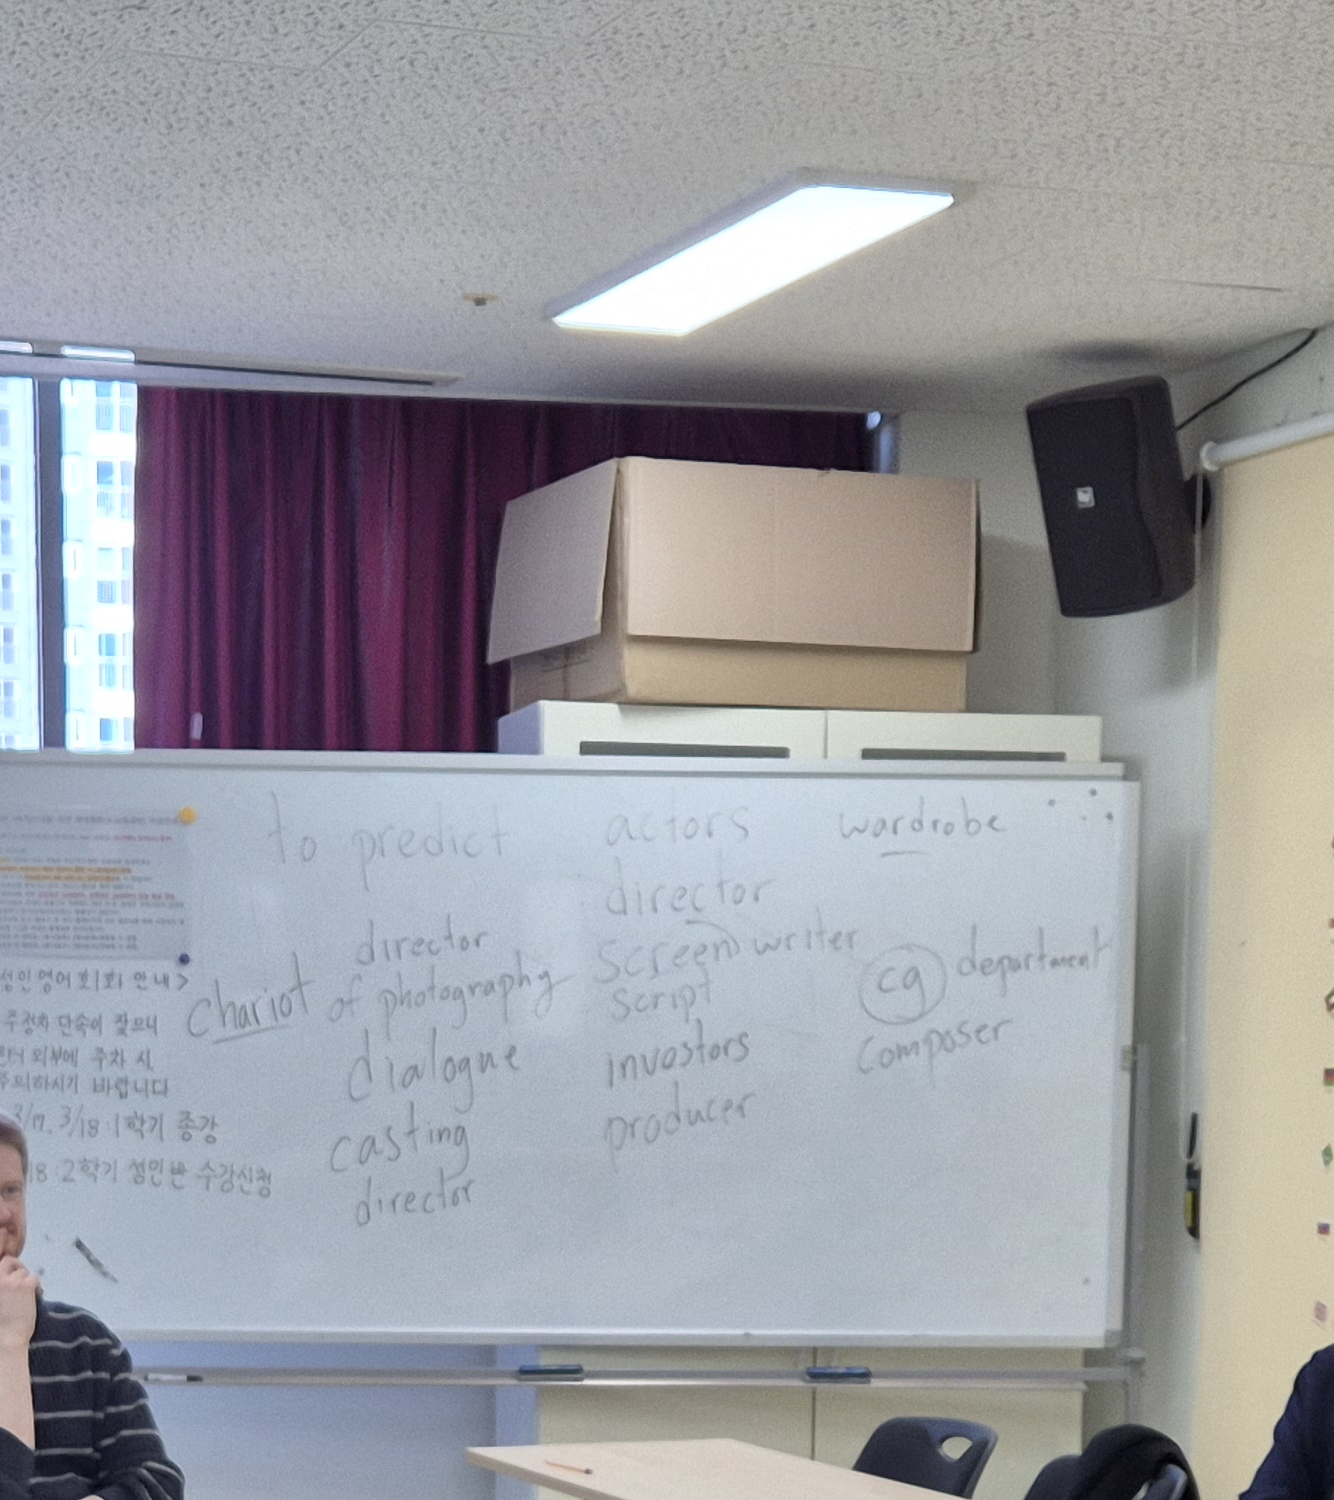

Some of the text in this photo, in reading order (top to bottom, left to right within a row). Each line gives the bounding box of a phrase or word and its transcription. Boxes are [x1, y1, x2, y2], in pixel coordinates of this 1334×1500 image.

[268, 791, 510, 892] to predict
[605, 790, 750, 847] actors
[839, 796, 1006, 838] wardrobe
[605, 850, 774, 916] director
[355, 913, 489, 966] director
[956, 923, 1113, 998] department
[327, 949, 575, 1042] of photography
[347, 1026, 521, 1115] dialogue
[329, 1100, 471, 1180] casting
[604, 1080, 756, 1173] producer
[356, 1166, 475, 1227] director
